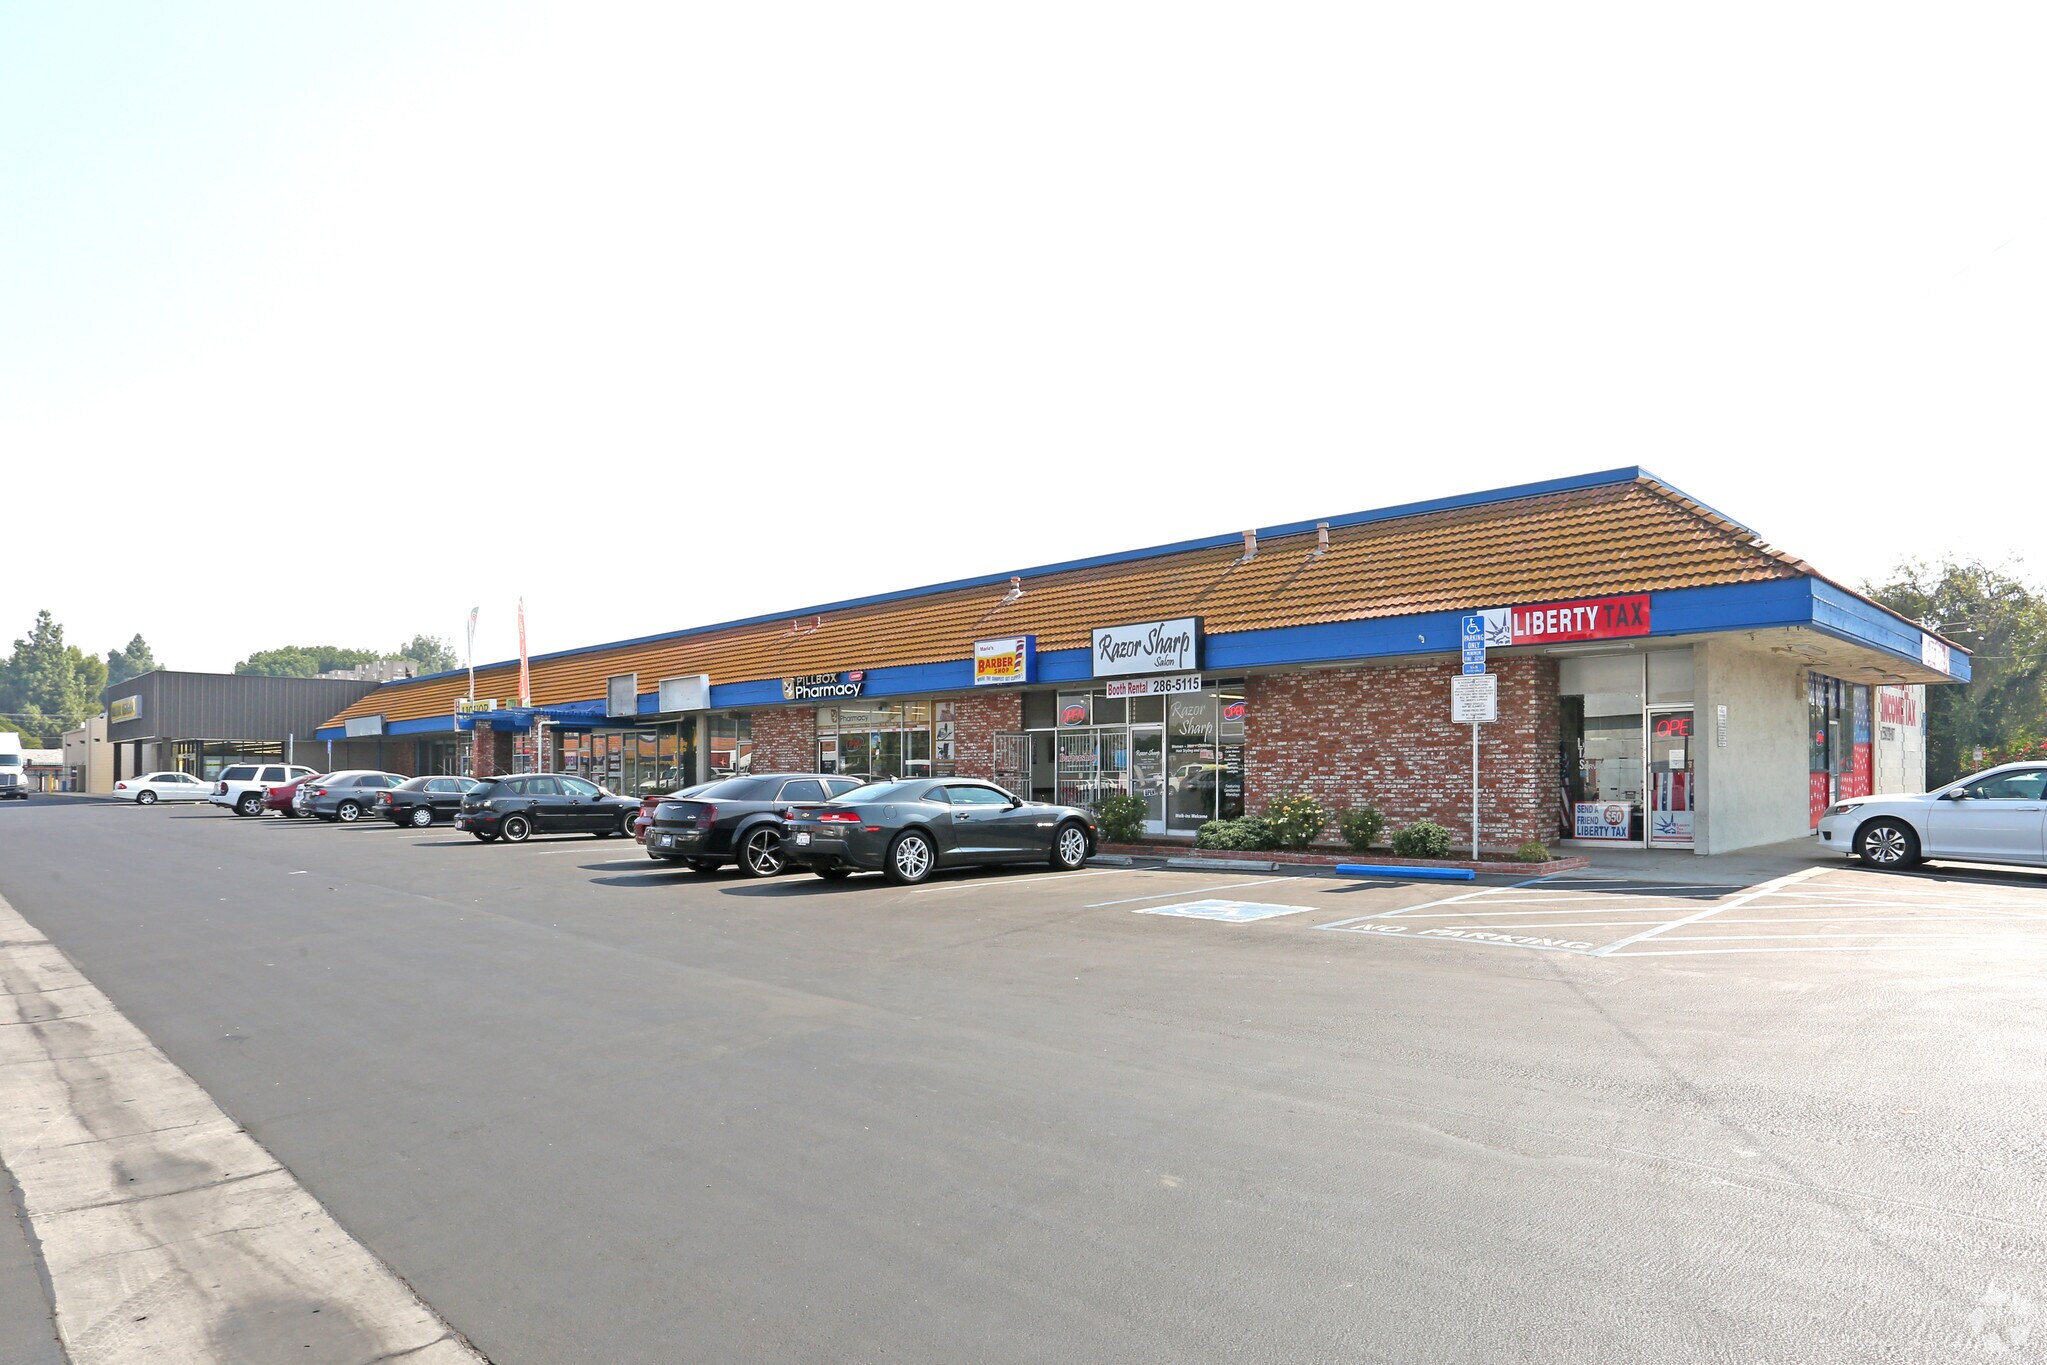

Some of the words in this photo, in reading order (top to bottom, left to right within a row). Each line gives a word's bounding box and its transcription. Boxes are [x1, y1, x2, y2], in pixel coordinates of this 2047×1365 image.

[1513, 606, 1599, 637] LIBERTY
[1603, 602, 1643, 627] TAX
[1464, 633, 1484, 641] PARKING
[1099, 634, 1142, 663] Razor
[1143, 622, 1190, 668] Sharp
[1467, 641, 1481, 649] ONLY
[978, 657, 1014, 673] BARBER
[1154, 653, 1175, 667] Salon
[796, 673, 838, 686] PILLBOX
[1107, 683, 1126, 696] Booth
[1127, 681, 1148, 695] Rental
[1153, 677, 1199, 693] 286-5115
[795, 682, 862, 699] Pharmacy
[1060, 708, 1086, 723] OPEN
[1170, 701, 1206, 719] Razor
[1223, 705, 1245, 718] OPEN
[1904, 698, 1917, 727] TAX
[840, 714, 869, 722] Pharmacy
[1178, 719, 1213, 743] Sharp
[1656, 718, 1692, 737] OPE
[1576, 804, 1593, 814] SEND
[1594, 805, 1599, 813] A
[1605, 810, 1622, 823] $50
[1576, 816, 1599, 825] FRIEND
[1576, 826, 1609, 837] LIBERTY
[1611, 827, 1627, 838] TAX
[1349, 923, 1409, 932] NO
[1416, 928, 1595, 949] PARKING
